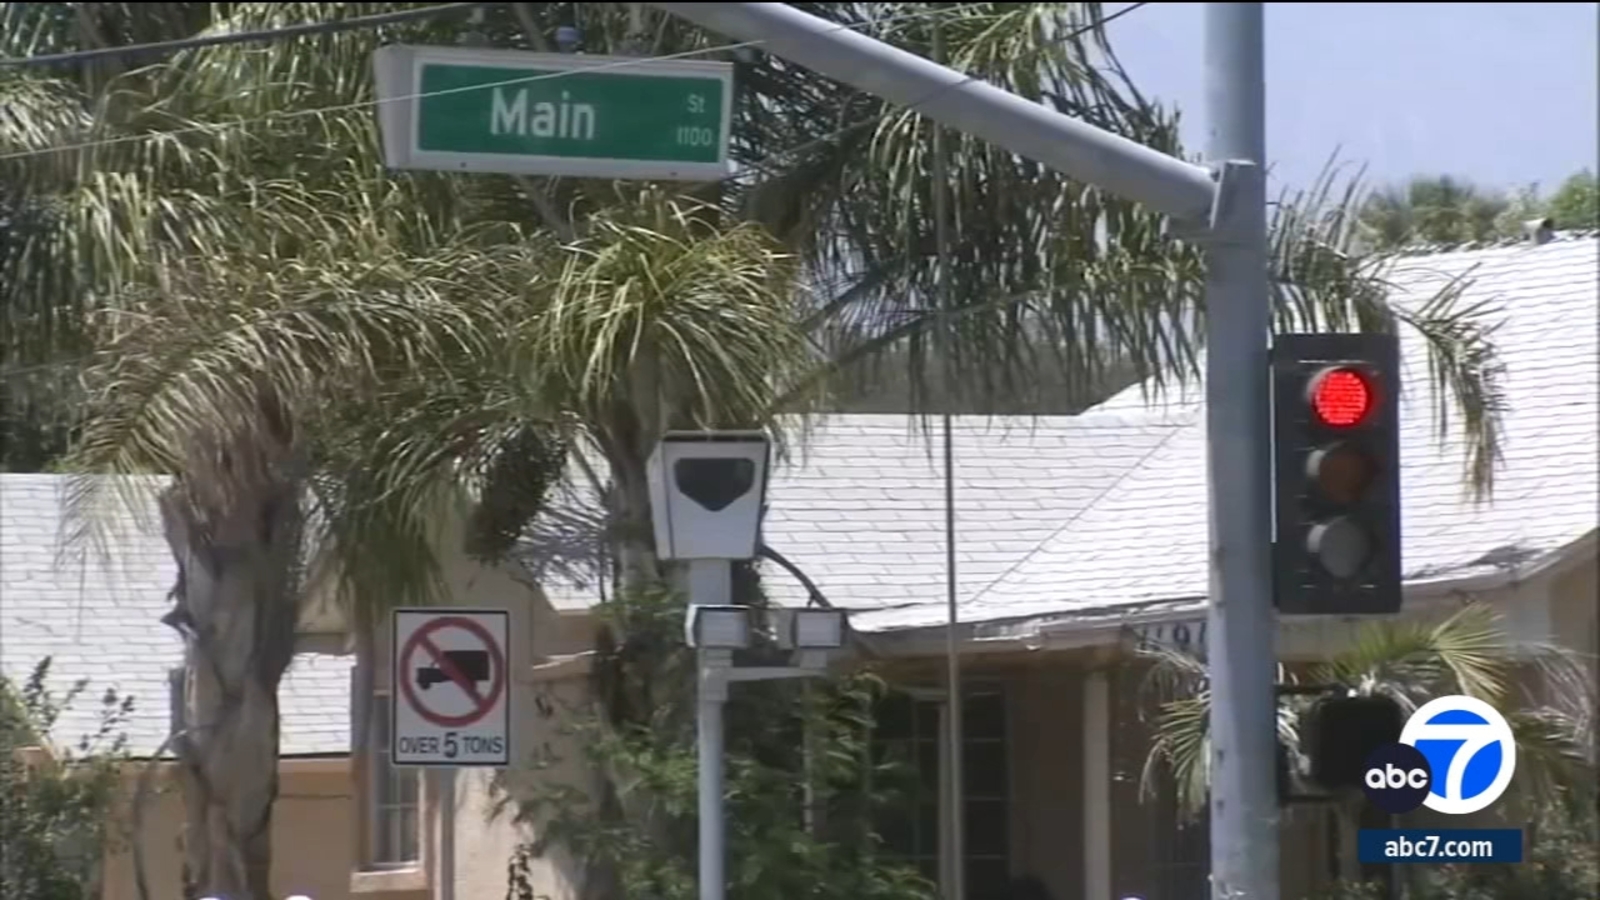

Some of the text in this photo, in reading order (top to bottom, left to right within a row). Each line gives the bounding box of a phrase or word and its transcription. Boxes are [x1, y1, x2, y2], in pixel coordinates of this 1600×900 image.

[490, 87, 595, 140] Main
[686, 93, 705, 113] St
[677, 126, 713, 147] 1100
[400, 731, 503, 758] OVER 5 TONS
